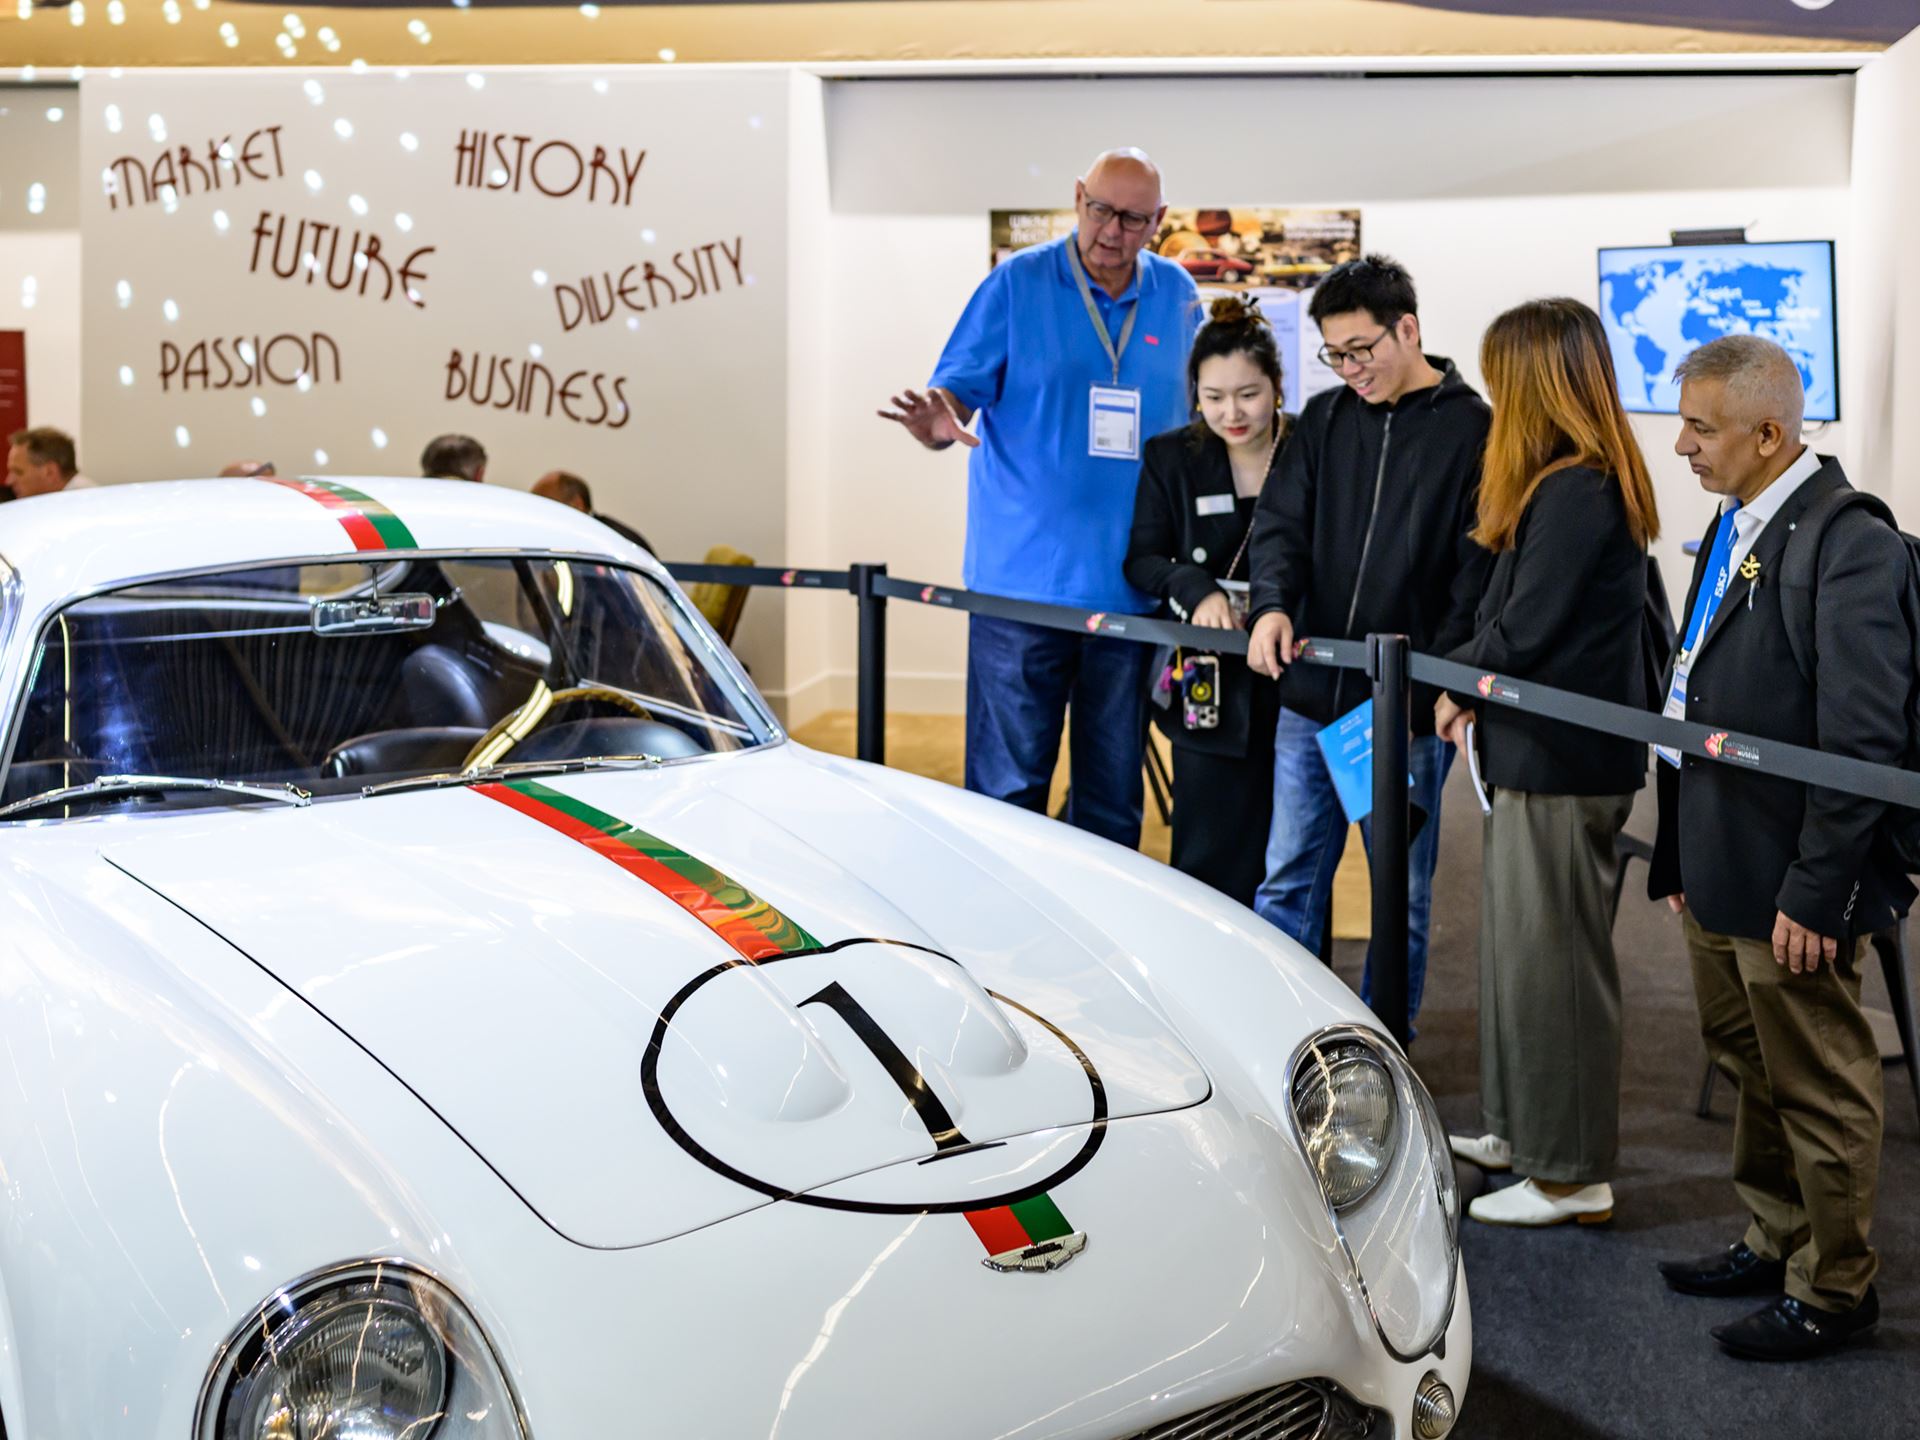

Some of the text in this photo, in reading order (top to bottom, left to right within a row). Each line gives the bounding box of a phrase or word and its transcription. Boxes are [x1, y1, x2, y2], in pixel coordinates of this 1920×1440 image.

[108, 126, 285, 210] MARKET
[455, 130, 646, 206] HISTORY
[250, 211, 436, 308] FUTURE
[554, 237, 743, 332] DIVERSITY
[159, 332, 342, 392] PASSION
[445, 349, 630, 429] BUSINESS
[796, 981, 1007, 1166] 1
